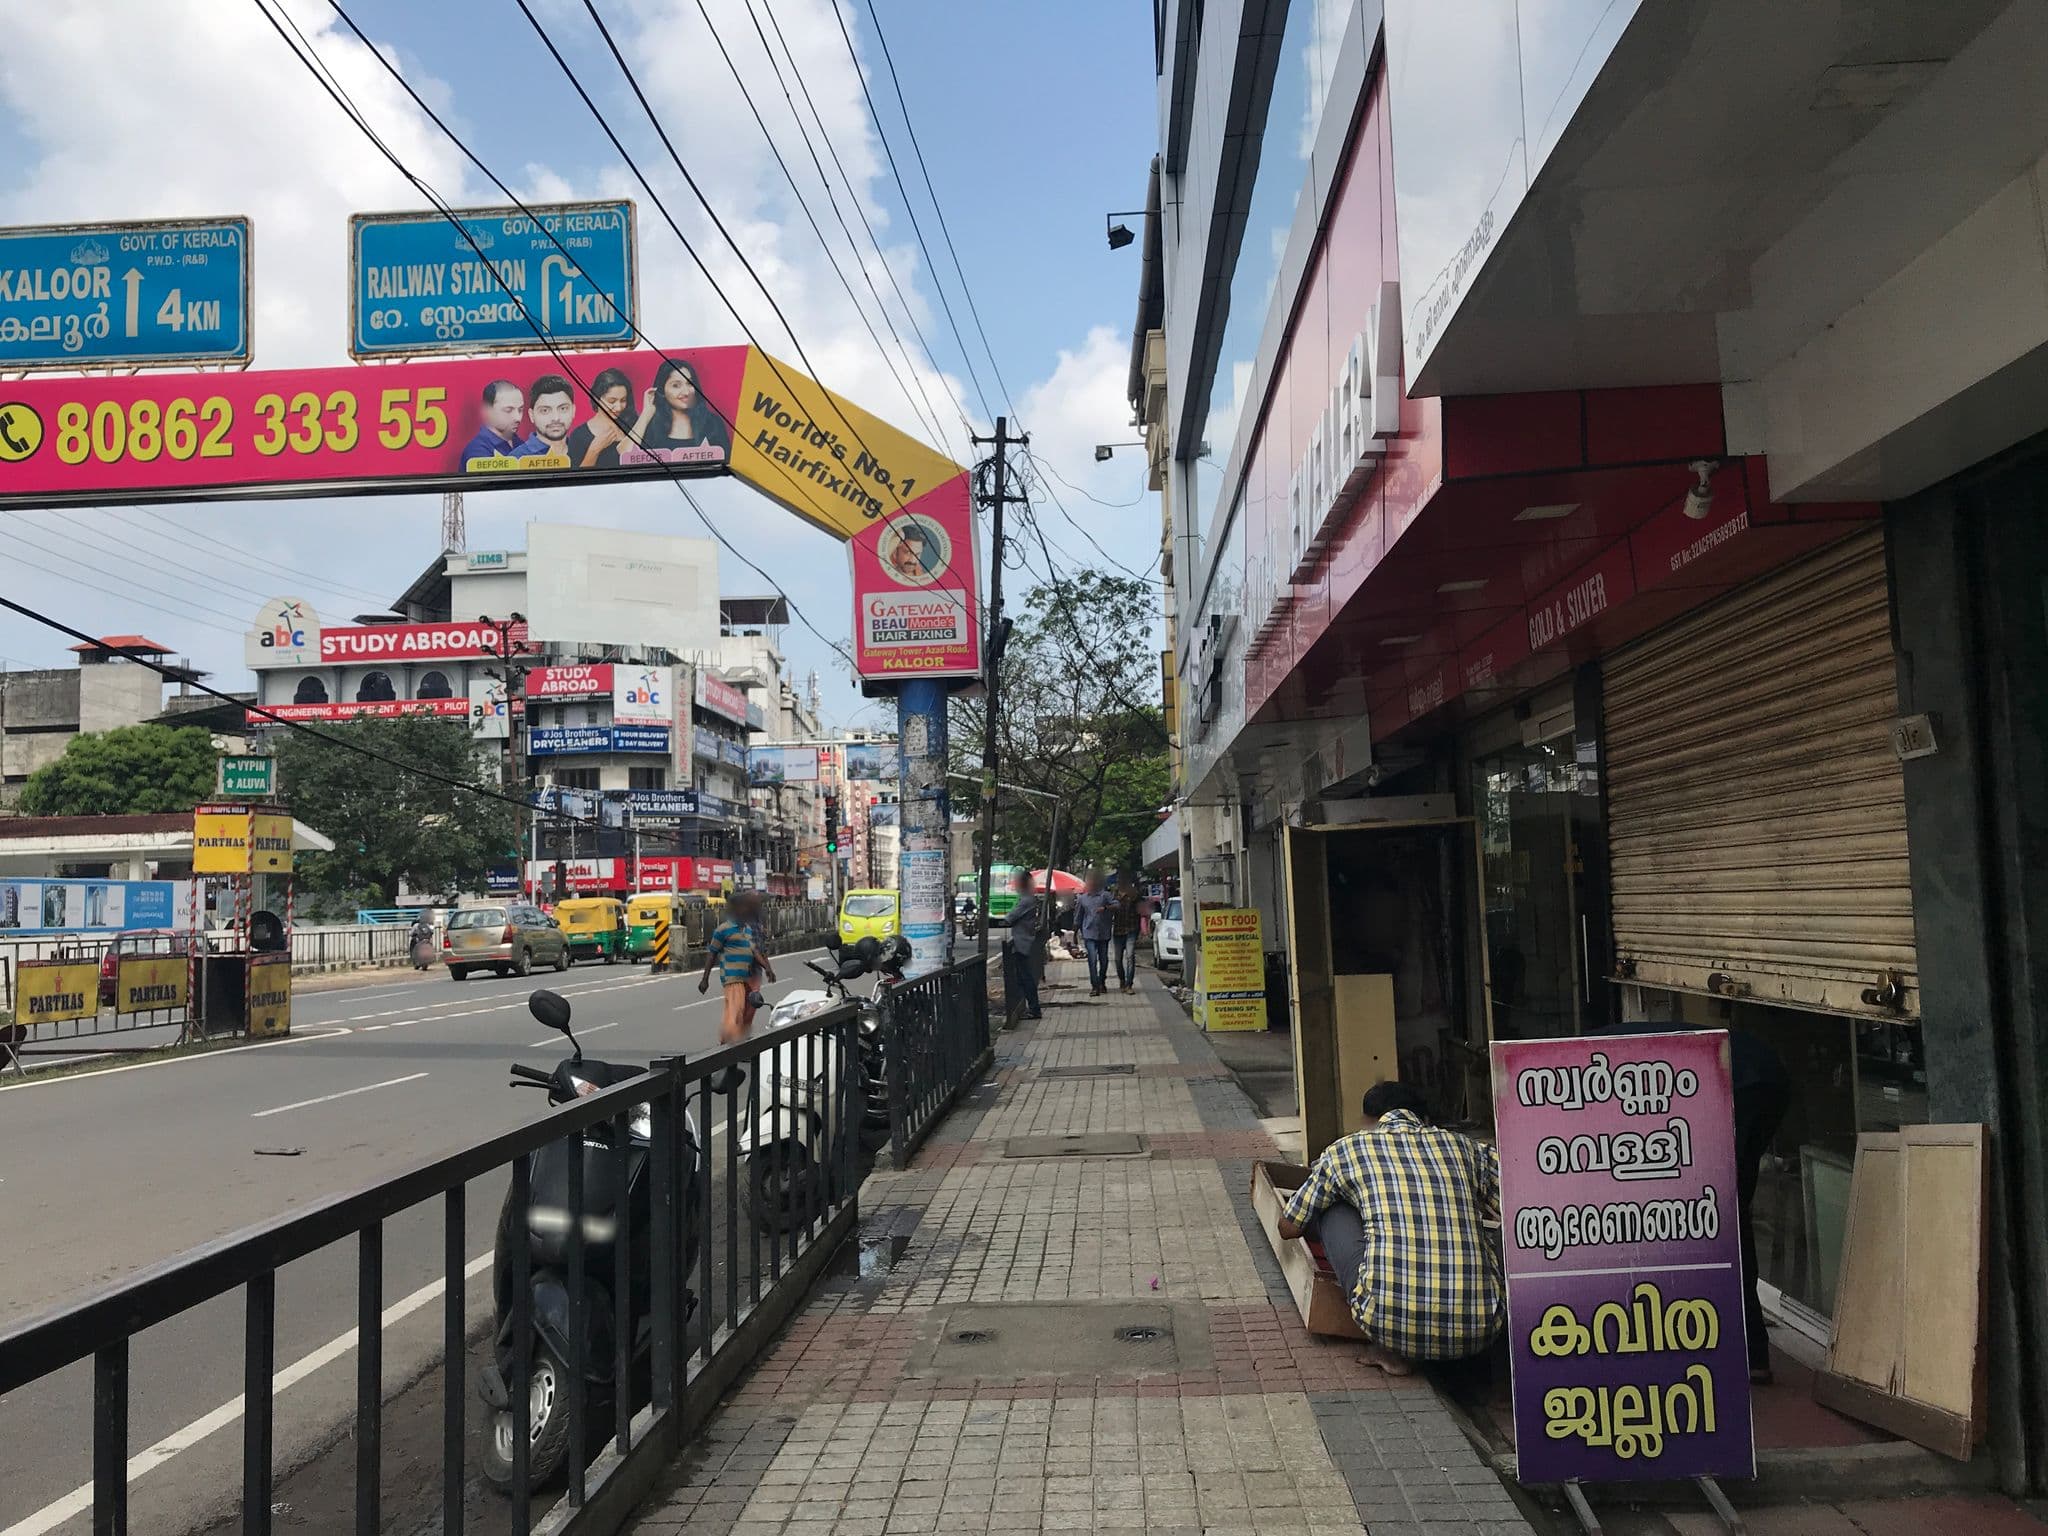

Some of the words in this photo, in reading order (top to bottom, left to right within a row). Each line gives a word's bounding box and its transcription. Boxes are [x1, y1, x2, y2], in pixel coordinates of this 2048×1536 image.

[503, 219, 540, 236] GOVT.
[547, 218, 563, 234] OF
[566, 215, 619, 232] KERALA
[120, 234, 158, 251] GOVT.
[162, 234, 179, 250] OF
[183, 231, 236, 249] KERALA
[147, 256, 174, 266] P.W.D.
[182, 254, 208, 266] (R&B)
[0, 266, 112, 302] KALOOR
[368, 264, 445, 299] RAILWAY
[451, 259, 526, 294] STATION
[0, 302, 111, 352] കലൂർ
[56, 395, 235, 465] 80862
[253, 390, 359, 456] 333
[378, 386, 449, 450] 55
[752, 391, 848, 460] World's
[477, 459, 509, 469] BEFORE
[528, 457, 560, 467] AFTER
[682, 450, 714, 461] AFTER
[754, 429, 884, 520] Hairfixing
[870, 600, 956, 617] GATEWAY
[1529, 608, 1553, 650] GOLD
[1556, 601, 1565, 636] &
[1566, 572, 1607, 629] SILVER
[872, 618, 907, 630] BEAU
[910, 617, 954, 629] Monde's
[260, 624, 305, 648] abc
[322, 632, 398, 656] STUDY
[402, 628, 498, 652] ABROAD
[876, 630, 907, 641] HAIR
[910, 629, 953, 640] FIXING
[883, 656, 945, 669] KALOOR
[546, 667, 592, 681] STUDY
[541, 679, 599, 693] ABROAD
[626, 687, 660, 705] abc
[277, 706, 332, 718] ENGINEERING
[444, 701, 468, 712] PILOT
[473, 700, 505, 718] abc
[565, 728, 599, 738] Brothers
[533, 737, 608, 749] DRYCLEANERS
[236, 760, 265, 772] VYPIN
[236, 778, 265, 789] ALUVA
[651, 792, 685, 802] Brothers
[198, 837, 245, 847] PARTHAS
[1205, 915, 1229, 926] FAST
[1232, 914, 1257, 926] FOOD
[130, 984, 176, 1004] PARTHAS
[29, 993, 84, 1014] PARTHAS
[1517, 1052, 1698, 1115] സ്വർണ്ണം
[1537, 1117, 1693, 1181] വെള്ളി
[1515, 1186, 1719, 1260] ആഭരണങ്ങൾ
[1530, 1282, 1720, 1357] കവിത
[1543, 1364, 1717, 1459] ജ്വല്ലറി
